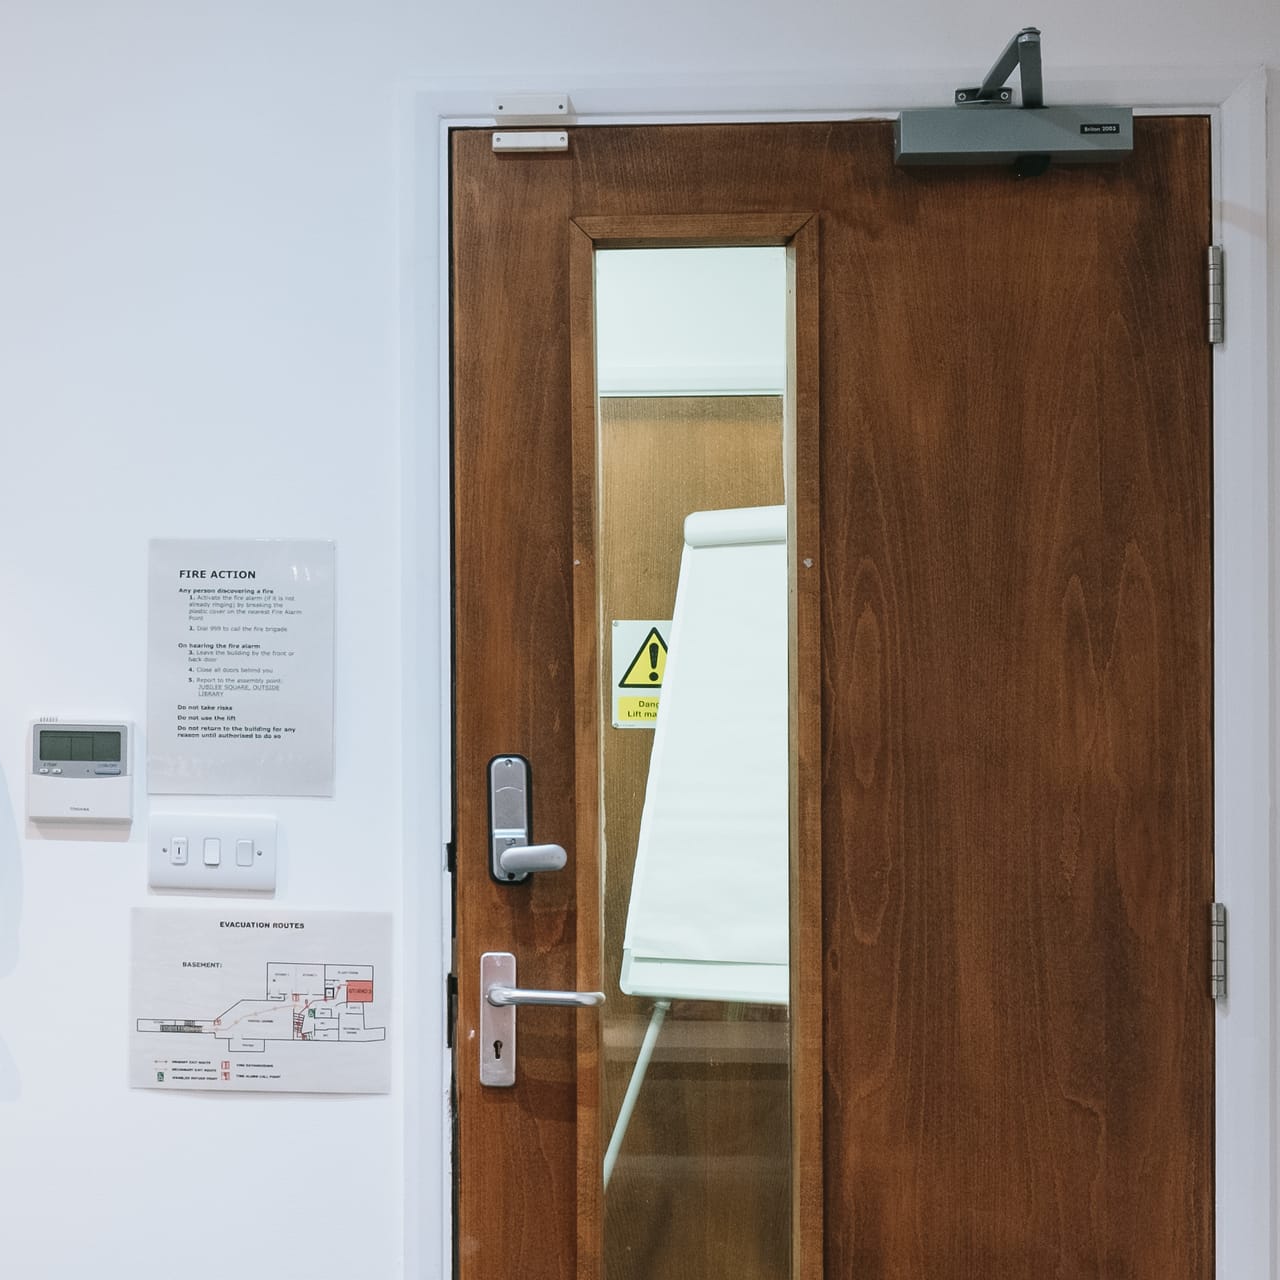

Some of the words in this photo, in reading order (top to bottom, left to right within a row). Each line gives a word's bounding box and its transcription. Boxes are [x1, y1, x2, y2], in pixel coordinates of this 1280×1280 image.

[179, 570, 207, 579] FIRE
[210, 570, 256, 579] ACTION
[627, 710, 642, 718] Lift
[219, 921, 270, 929] EVACUATION
